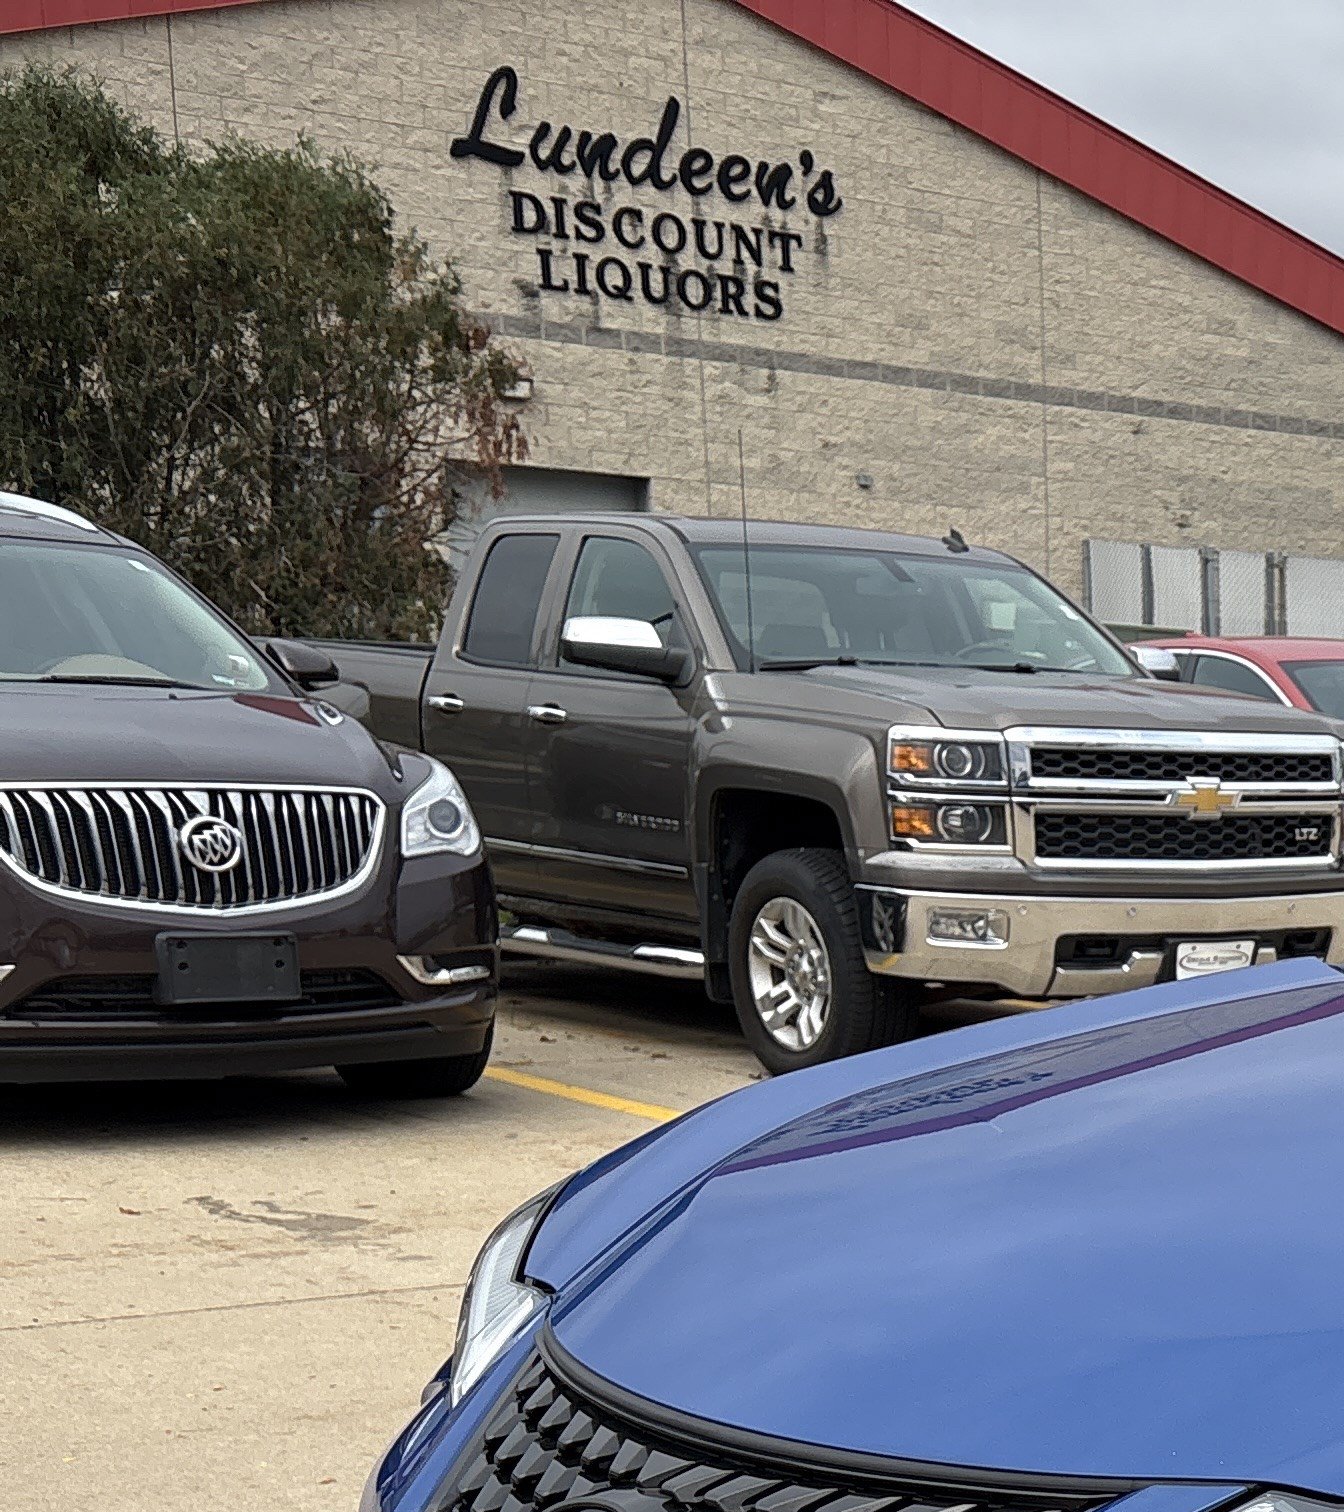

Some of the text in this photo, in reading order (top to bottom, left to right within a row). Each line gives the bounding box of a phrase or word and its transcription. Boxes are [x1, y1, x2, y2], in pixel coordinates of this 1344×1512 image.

[450, 65, 843, 217] Lundeen's
[508, 188, 803, 274] DISCOUNT
[536, 247, 784, 321] LIQUORS
[1294, 827, 1319, 841] LTZ
